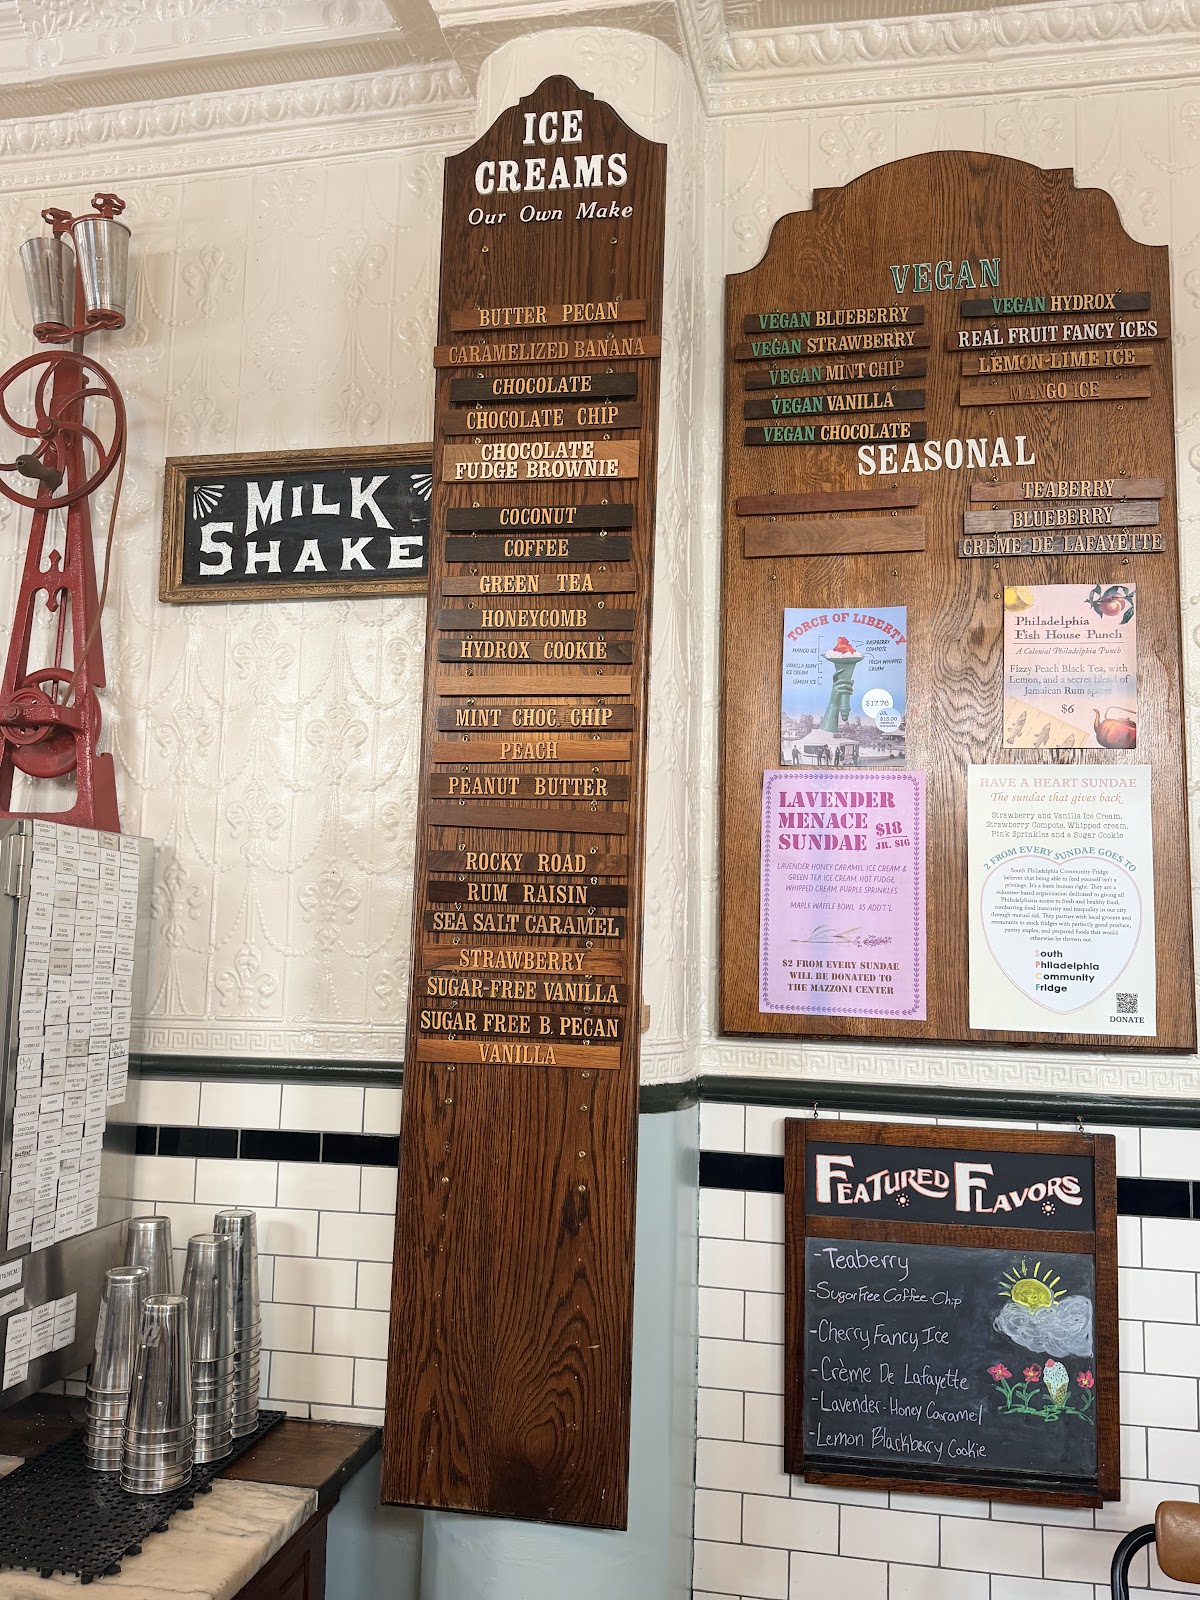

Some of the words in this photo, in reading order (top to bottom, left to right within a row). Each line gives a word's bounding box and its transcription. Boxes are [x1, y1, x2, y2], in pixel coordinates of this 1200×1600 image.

[523, 110, 584, 146] ICE
[475, 153, 628, 195] CREAMS
[468, 208, 507, 225] Our
[520, 205, 563, 223] Own
[576, 201, 634, 220] Make
[890, 258, 1001, 294] VEGAN
[480, 306, 548, 327] BUTTER
[562, 302, 619, 322] PECAN
[992, 296, 1047, 315] VEGAN
[1051, 294, 1116, 312] HYDROX
[759, 312, 812, 330] VEGAN
[815, 307, 910, 327] BLUEBERRY
[752, 339, 802, 357] VEGAN
[807, 331, 915, 354] STRAWBERRY
[958, 330, 1004, 348] REAL
[1008, 325, 1059, 345] FRUIT
[1062, 322, 1116, 341] FANCY
[1119, 321, 1158, 338] ICES
[449, 341, 570, 364] CARAMELIZED
[574, 337, 646, 358] BANANA
[978, 351, 1100, 373] LEMON-LIME
[1105, 349, 1136, 366] ICE
[769, 366, 822, 386] VEGAN
[825, 363, 866, 381] MINT
[869, 360, 905, 378] CHIP
[492, 376, 592, 395] CHOCOLATE
[1009, 382, 1068, 401] MANGO
[1073, 382, 1100, 399] ICE
[771, 396, 823, 415] VEGAN
[827, 392, 894, 412] VANILLA
[467, 409, 564, 430] CHOCOLATE
[577, 407, 619, 426] CHIP
[764, 426, 816, 442] VEGAN
[820, 423, 911, 441] CHOCOLATE
[481, 441, 595, 461] CHOCOLATE
[857, 435, 1036, 477] SEASONAL
[455, 462, 518, 480] FUDGE
[526, 459, 619, 478] BROWNIE
[1022, 480, 1116, 499] TEABERRY
[245, 475, 395, 537] MILK
[499, 508, 577, 525] COCONUT
[1012, 507, 1114, 529] BLUEBERRY
[200, 522, 424, 576] SHAKE
[504, 539, 569, 557] COFFEE
[963, 538, 1023, 556] CREME
[1031, 537, 1054, 554] DE
[1063, 534, 1163, 553] LAFAYETTE
[480, 575, 540, 594] GREEN
[557, 573, 594, 592] TEA
[481, 609, 587, 628] HONEYCOMB
[1015, 616, 1090, 629] Philadelphia
[787, 615, 829, 641] TORCH
[832, 613, 850, 623] OF
[853, 614, 907, 646] LIBERTY
[1014, 630, 1040, 640] Fish
[1045, 630, 1081, 639] House
[1086, 629, 1122, 639] Punch
[461, 641, 530, 659] HYDROX
[543, 642, 607, 659] COOKIE
[1053, 647, 1097, 656] Philadelphia
[1098, 647, 1122, 655] Punch
[1010, 665, 1032, 676] Fizzy
[1035, 665, 1060, 673] Peach
[1062, 664, 1085, 673] Black
[1088, 665, 1106, 674] Tea,
[1108, 664, 1128, 673] with
[456, 708, 502, 727] MINT
[512, 708, 561, 727] CHOC.
[570, 708, 613, 727] CHIP
[1061, 704, 1075, 714] $6
[500, 741, 559, 760] PEACH
[449, 777, 520, 795] PEANUT
[535, 778, 608, 797] BUTTER
[980, 778, 1017, 788] HAVE
[1020, 778, 1030, 788] A
[1033, 778, 1078, 788] HEART
[1081, 778, 1137, 788] SUNDAE
[779, 791, 896, 809] LAVENDER
[991, 792, 1009, 802] The
[1011, 792, 1046, 802] sundae
[1048, 792, 1069, 802] that
[1071, 793, 1096, 805] gives
[1099, 793, 1124, 805] back
[779, 813, 868, 829] MENACE
[876, 821, 903, 837] $18
[779, 834, 868, 852] SUNDAE
[876, 842, 892, 850] JR.
[895, 839, 911, 848] $16
[466, 852, 523, 872] ROCKY
[538, 854, 586, 873] ROAD
[811, 863, 833, 871] HONEY
[834, 864, 865, 872] CARAMEL
[990, 847, 1018, 865] FROM
[1019, 846, 1053, 857] EVERY
[1053, 847, 1096, 861] SUNDAE
[1098, 847, 1124, 863] GOES
[1124, 859, 1137, 872] TO
[467, 884, 509, 902] RUM
[523, 885, 588, 904] RAISIN
[433, 912, 469, 931] SEA
[473, 914, 520, 933] SALT
[525, 916, 620, 937] CARAMEL
[460, 949, 586, 972] STRAWBERRY
[1035, 950, 1063, 958] South
[782, 959, 793, 968] $2
[796, 960, 823, 968] FROM
[826, 960, 857, 969] EVERY
[860, 962, 900, 971] SUNDAE
[1035, 961, 1100, 971] Philadelphia
[790, 972, 813, 980] WILL
[832, 973, 876, 982] DONATED
[879, 974, 892, 982] TO
[1035, 973, 1095, 984] Community
[427, 977, 537, 1000] SUGAR-FREE
[544, 983, 619, 1004] VANILLA
[787, 984, 808, 992] THE
[811, 984, 852, 993] MAZZONI
[856, 986, 894, 995] CENTER
[1036, 984, 1068, 993] Fridge
[420, 1010, 477, 1032] SUGAR
[484, 1013, 531, 1034] FREE
[560, 1017, 619, 1038] PECAN
[1109, 1016, 1145, 1024] DONATE
[479, 1044, 557, 1065] VANILLA
[954, 1161, 1083, 1214] FLAVORS
[873, 1324, 919, 1352] Fancy
[922, 1326, 950, 1345] Ice
[880, 1363, 895, 1384] De
[904, 1364, 969, 1395] Lafayette
[926, 1401, 983, 1425] Caramel
[872, 1427, 943, 1462] Blackberry
[948, 1439, 987, 1459] Cookie
